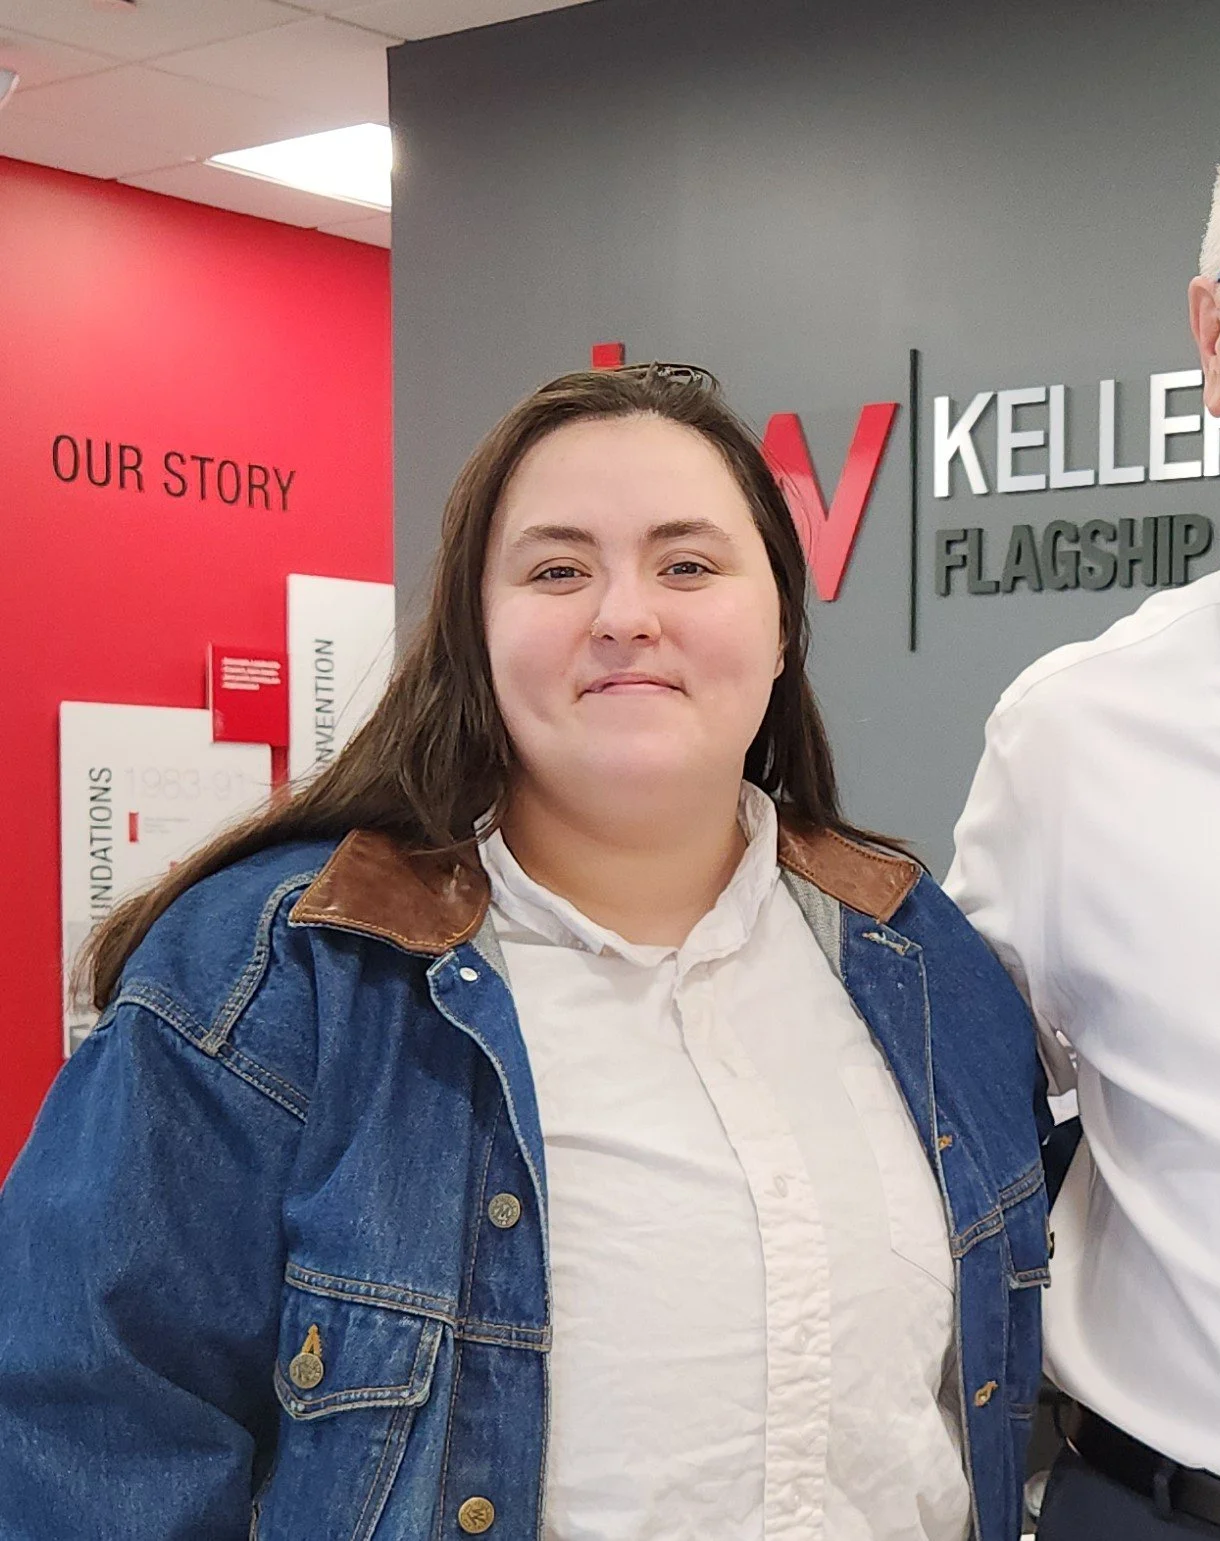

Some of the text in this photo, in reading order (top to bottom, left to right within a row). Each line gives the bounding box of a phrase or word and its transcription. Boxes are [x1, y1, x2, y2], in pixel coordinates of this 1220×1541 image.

[52, 434, 296, 511] OUR STORY
[935, 514, 1213, 597] FLAGSHIP
